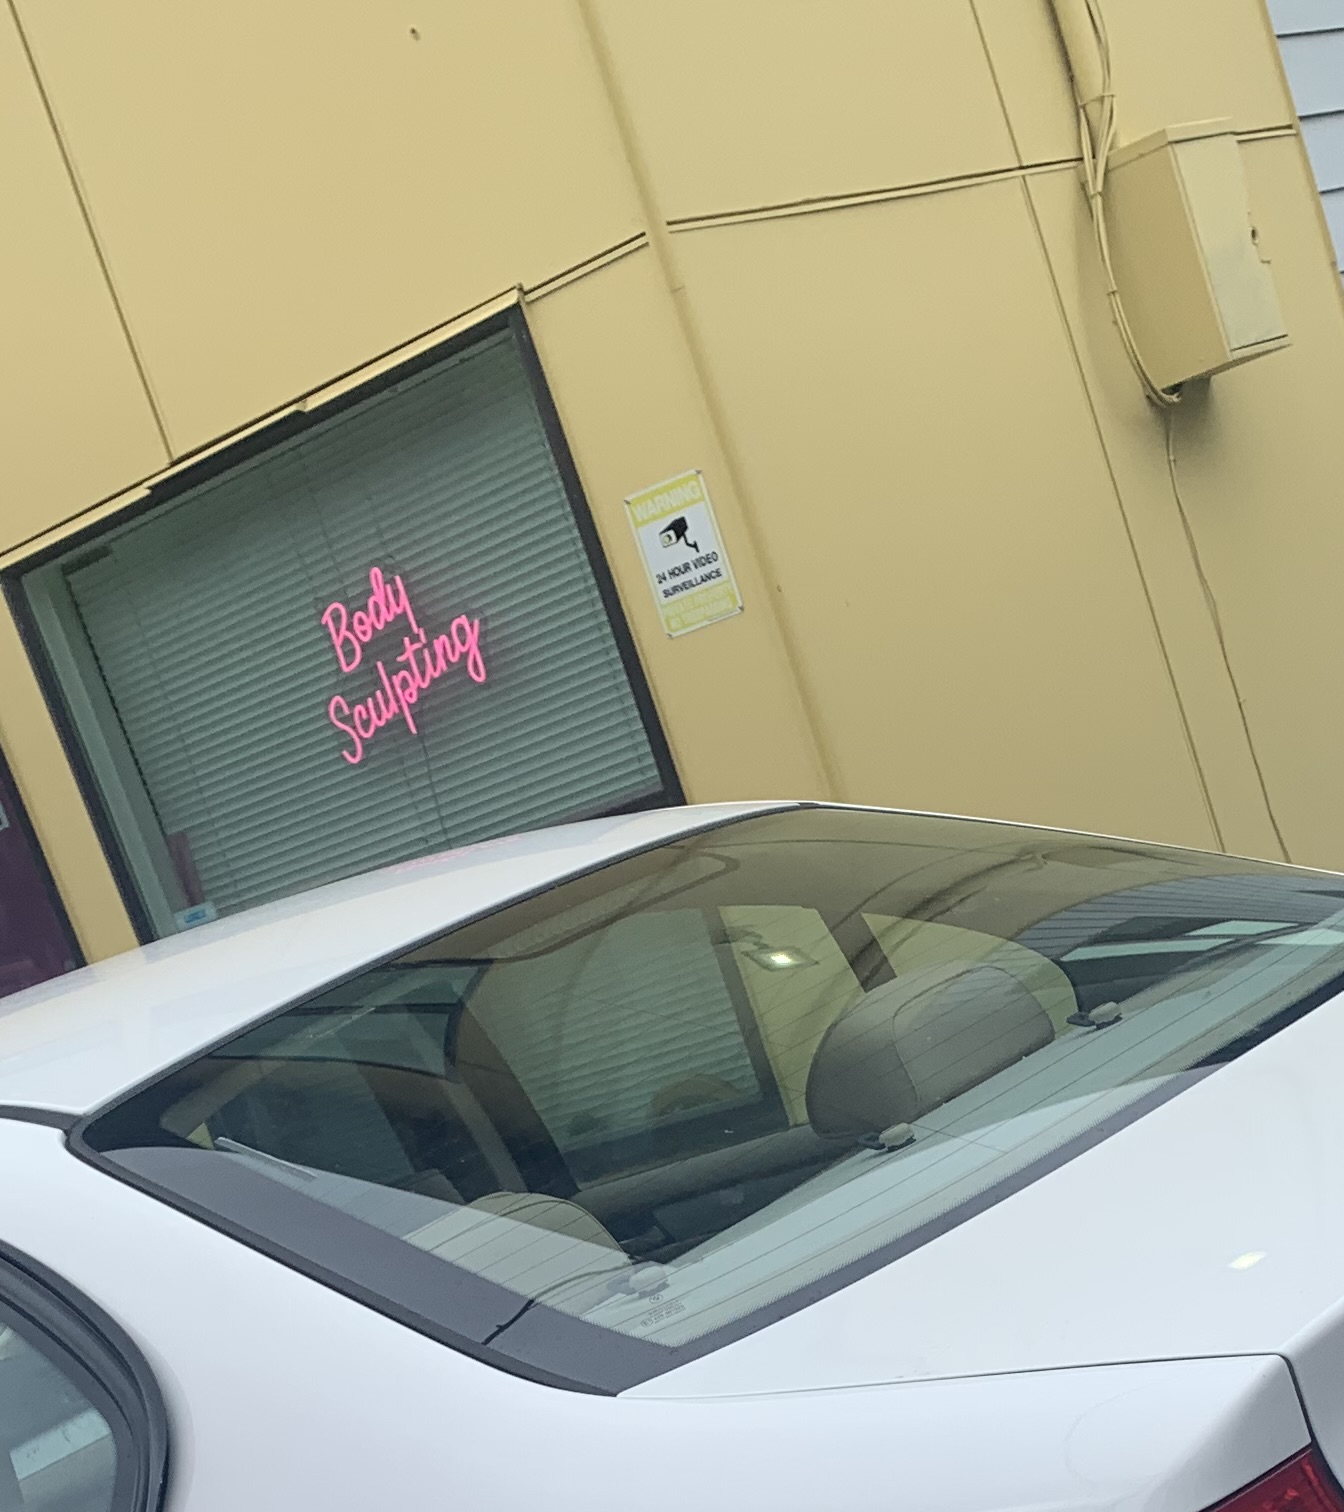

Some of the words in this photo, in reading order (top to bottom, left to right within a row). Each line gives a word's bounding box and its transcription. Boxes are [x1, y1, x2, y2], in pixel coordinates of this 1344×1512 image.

[634, 480, 703, 522] WARNING
[656, 573, 667, 585] 24
[668, 561, 691, 580] HOUR
[691, 551, 719, 570] VIDEO
[662, 568, 723, 599] SURVEILLANCE
[321, 566, 419, 673] Body
[328, 614, 486, 764] Sculpting
